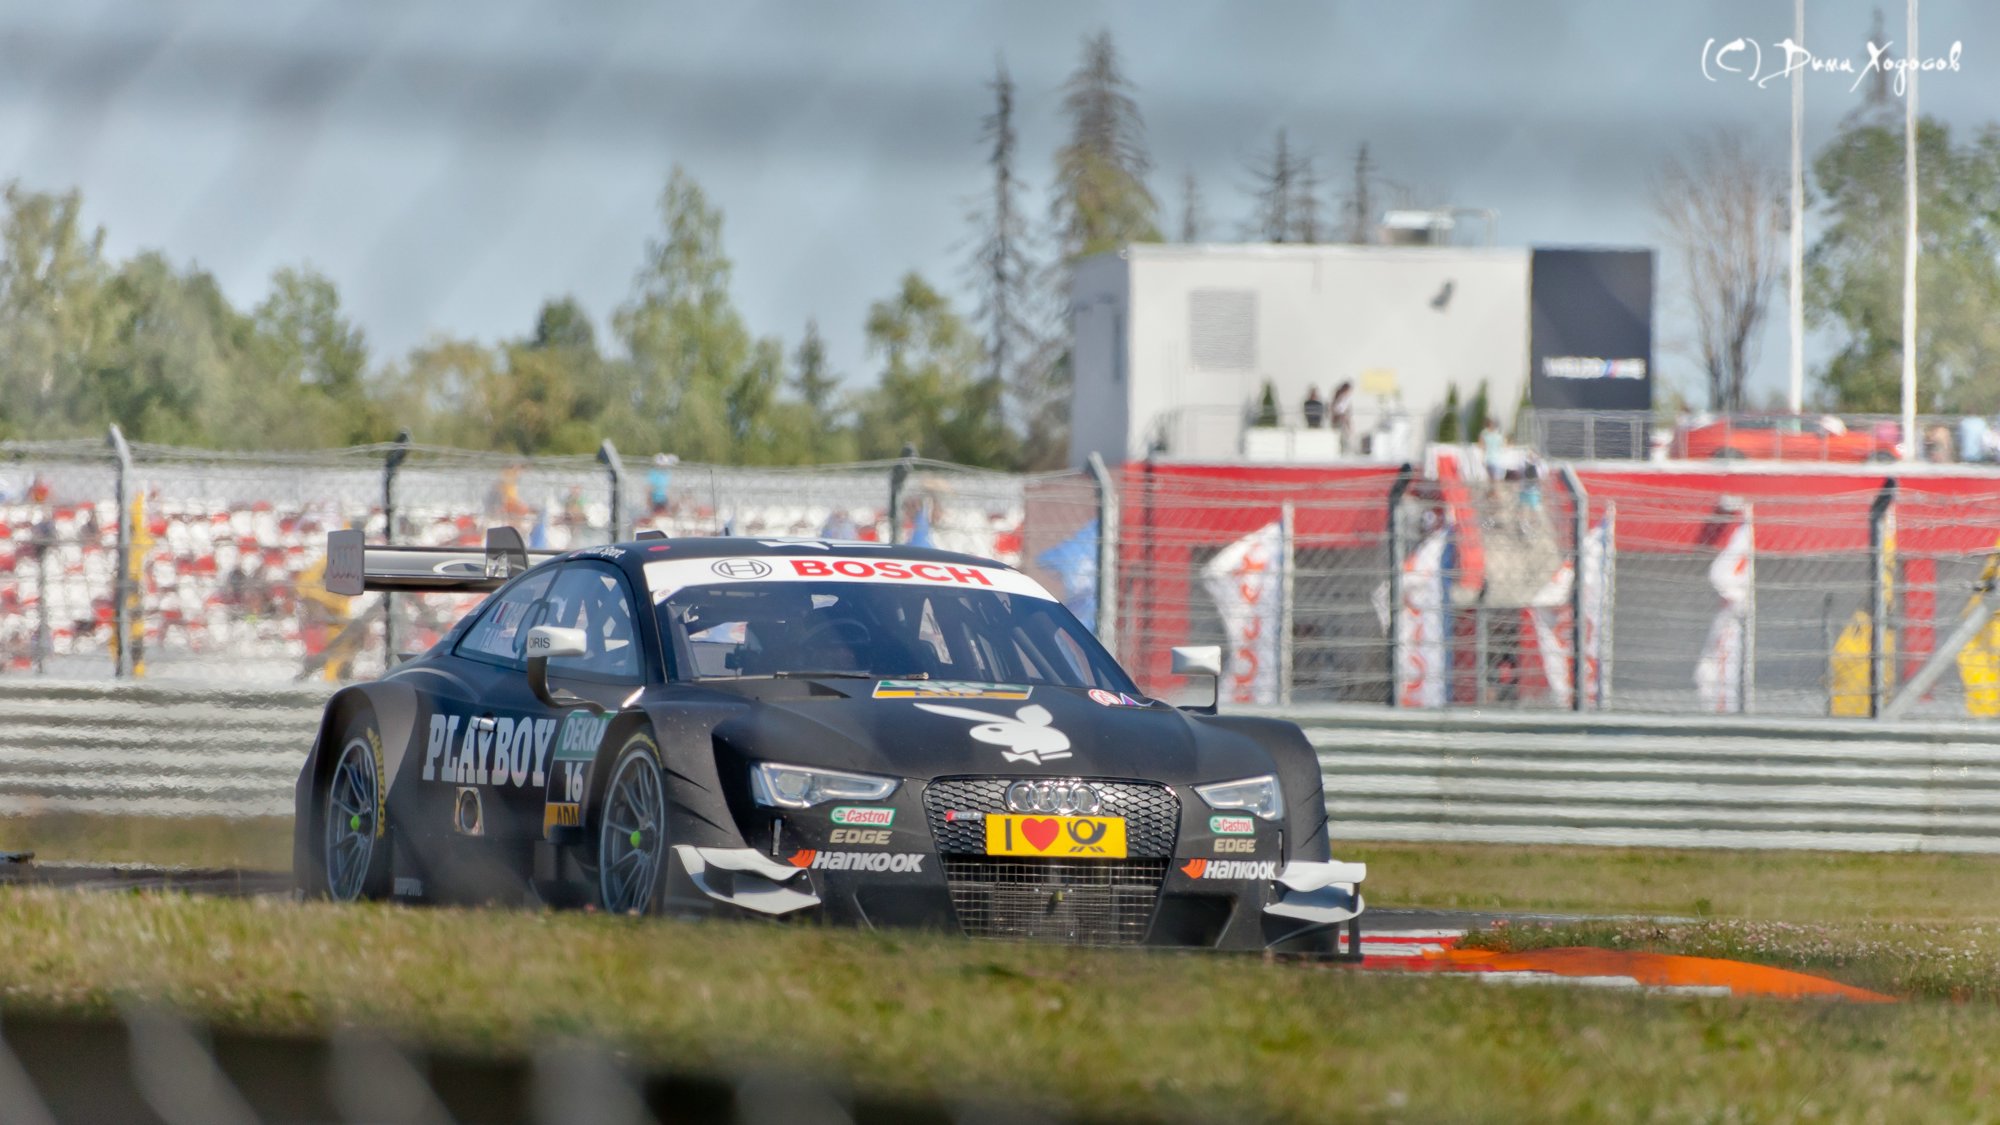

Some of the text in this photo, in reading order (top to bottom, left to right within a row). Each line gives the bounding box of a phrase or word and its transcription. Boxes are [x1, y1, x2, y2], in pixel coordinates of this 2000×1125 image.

[789, 559, 994, 586] BOSCH
[529, 637, 551, 649] ORIS
[422, 713, 557, 788] PLAYBOY
[564, 761, 584, 803] 16
[846, 809, 891, 825] Castrol
[1222, 819, 1253, 832] Castrol
[829, 828, 893, 845] EDGE
[1213, 838, 1257, 853] EDGE
